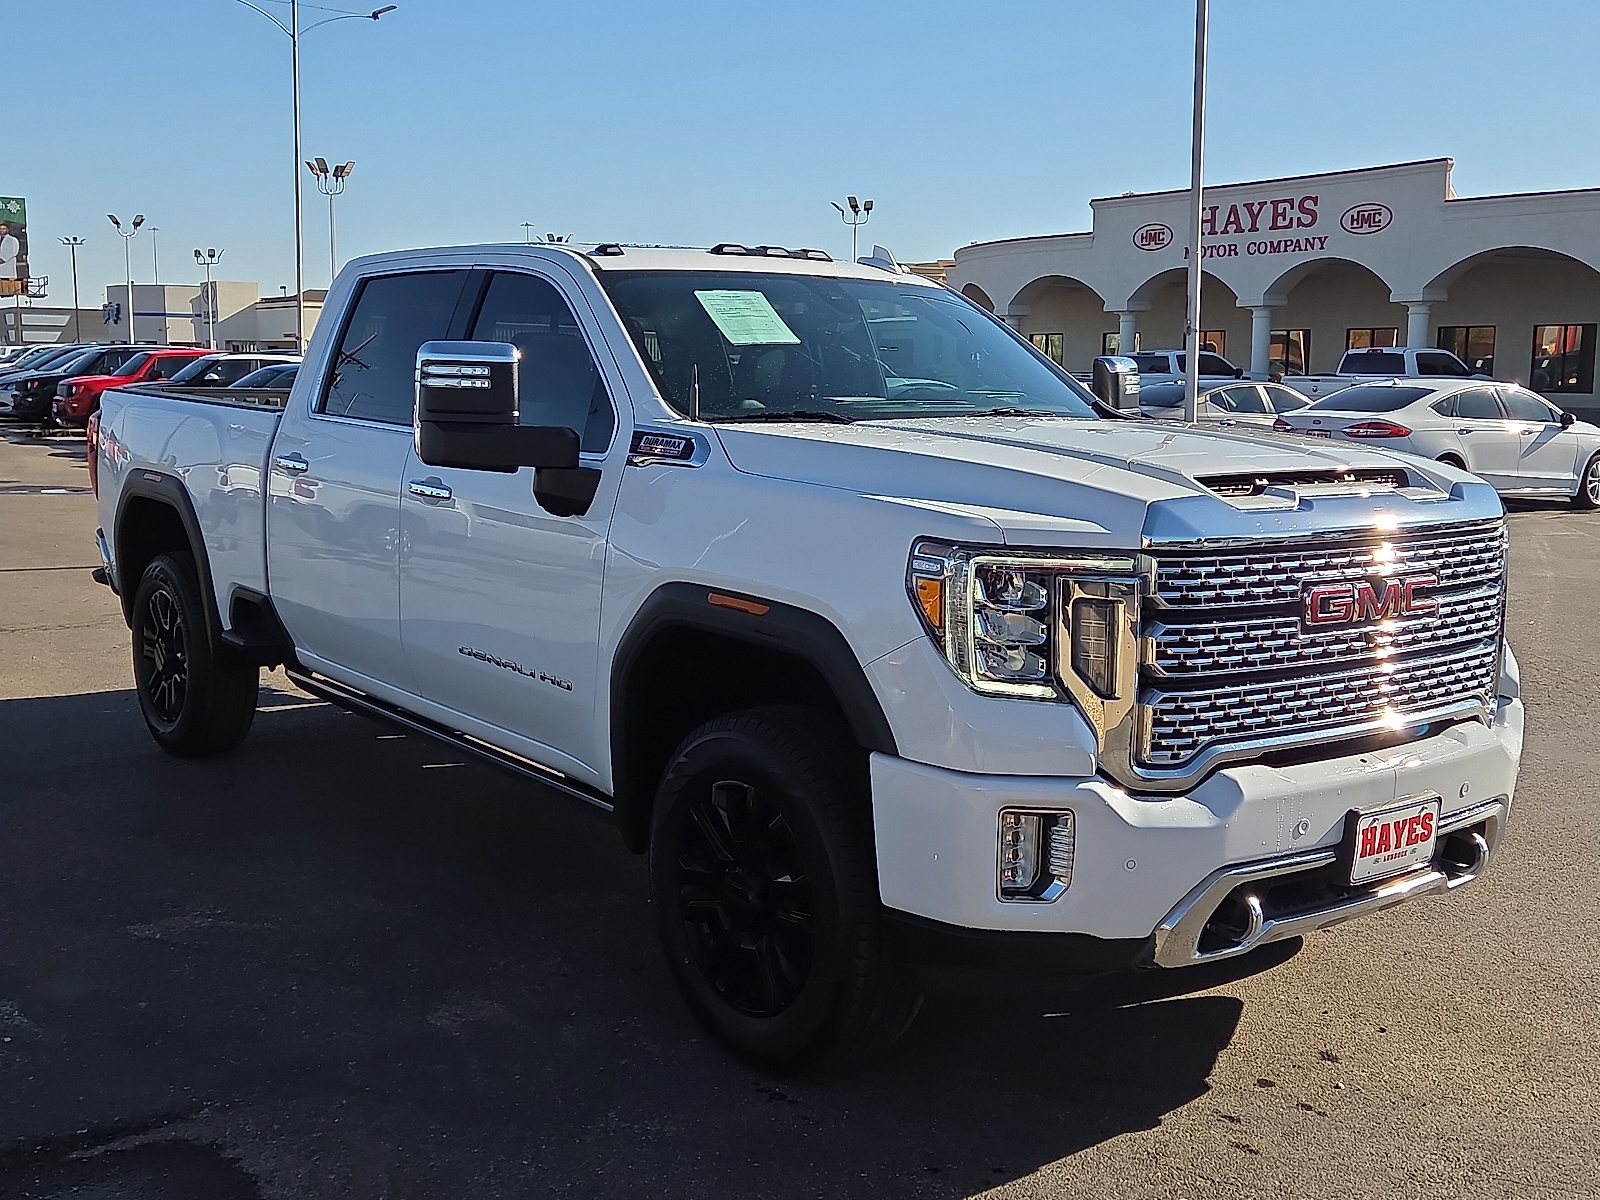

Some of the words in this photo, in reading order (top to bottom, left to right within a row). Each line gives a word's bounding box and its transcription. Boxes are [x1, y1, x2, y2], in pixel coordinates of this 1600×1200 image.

[1201, 195, 1319, 236] HAYES
[1350, 208, 1383, 230] HMC
[1140, 228, 1165, 246] HMC
[1246, 235, 1329, 256] COMPANY
[643, 436, 684, 450] DURAMAX
[1306, 574, 1437, 625] GMC
[458, 645, 536, 678] DENALI
[539, 671, 573, 692] HD
[1360, 812, 1433, 858] HAYES
